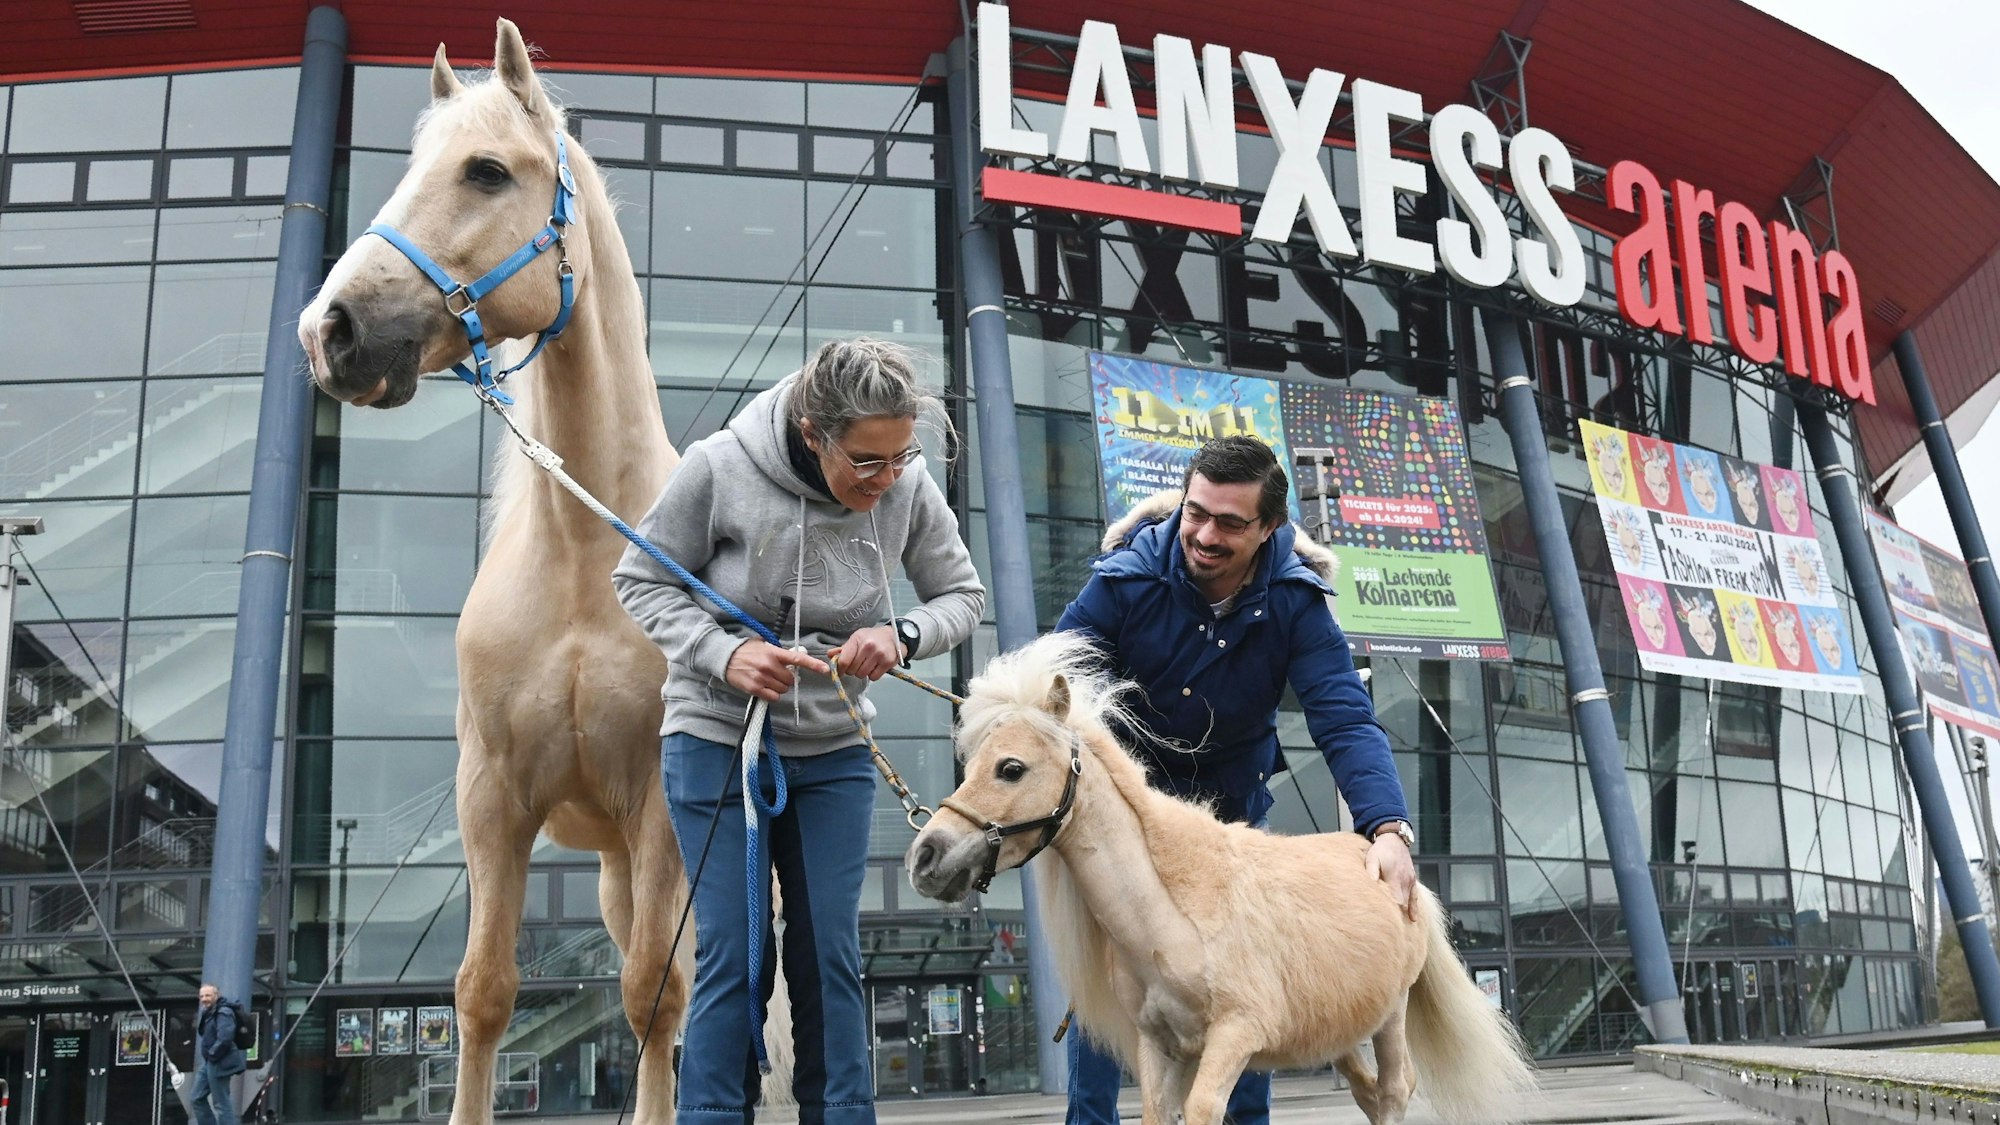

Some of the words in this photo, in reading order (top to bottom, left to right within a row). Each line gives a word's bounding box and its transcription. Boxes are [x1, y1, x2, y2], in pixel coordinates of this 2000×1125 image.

[977, 2, 1587, 307] LANXESS
[1605, 160, 1877, 405] arena
[1177, 409, 1214, 437] IM
[1121, 457, 1164, 471] KASALLA
[1171, 464, 1185, 473] HÖ
[1128, 470, 1160, 483] BLÄCK
[1162, 476, 1182, 486] FÖÖ
[1343, 500, 1383, 511] TICKETS
[1386, 502, 1401, 512] für
[1403, 504, 1433, 514] 2025:
[1359, 513, 1372, 522] ab
[1665, 515, 1705, 530] LANXESS
[1706, 523, 1735, 534] ARENA
[1735, 527, 1754, 539] KÖLN
[1715, 534, 1733, 546] JULI
[1735, 539, 1757, 552] 2024
[1647, 510, 1713, 584] FASHION
[1714, 568, 1751, 593] FREAK
[1750, 532, 1786, 601] SHOW
[1382, 568, 1451, 586] Lachende
[1355, 581, 1457, 607] Kölnarena
[1442, 644, 1480, 658] LANXESS
[1480, 646, 1509, 659] arena
[23, 984, 80, 996] Südwest
